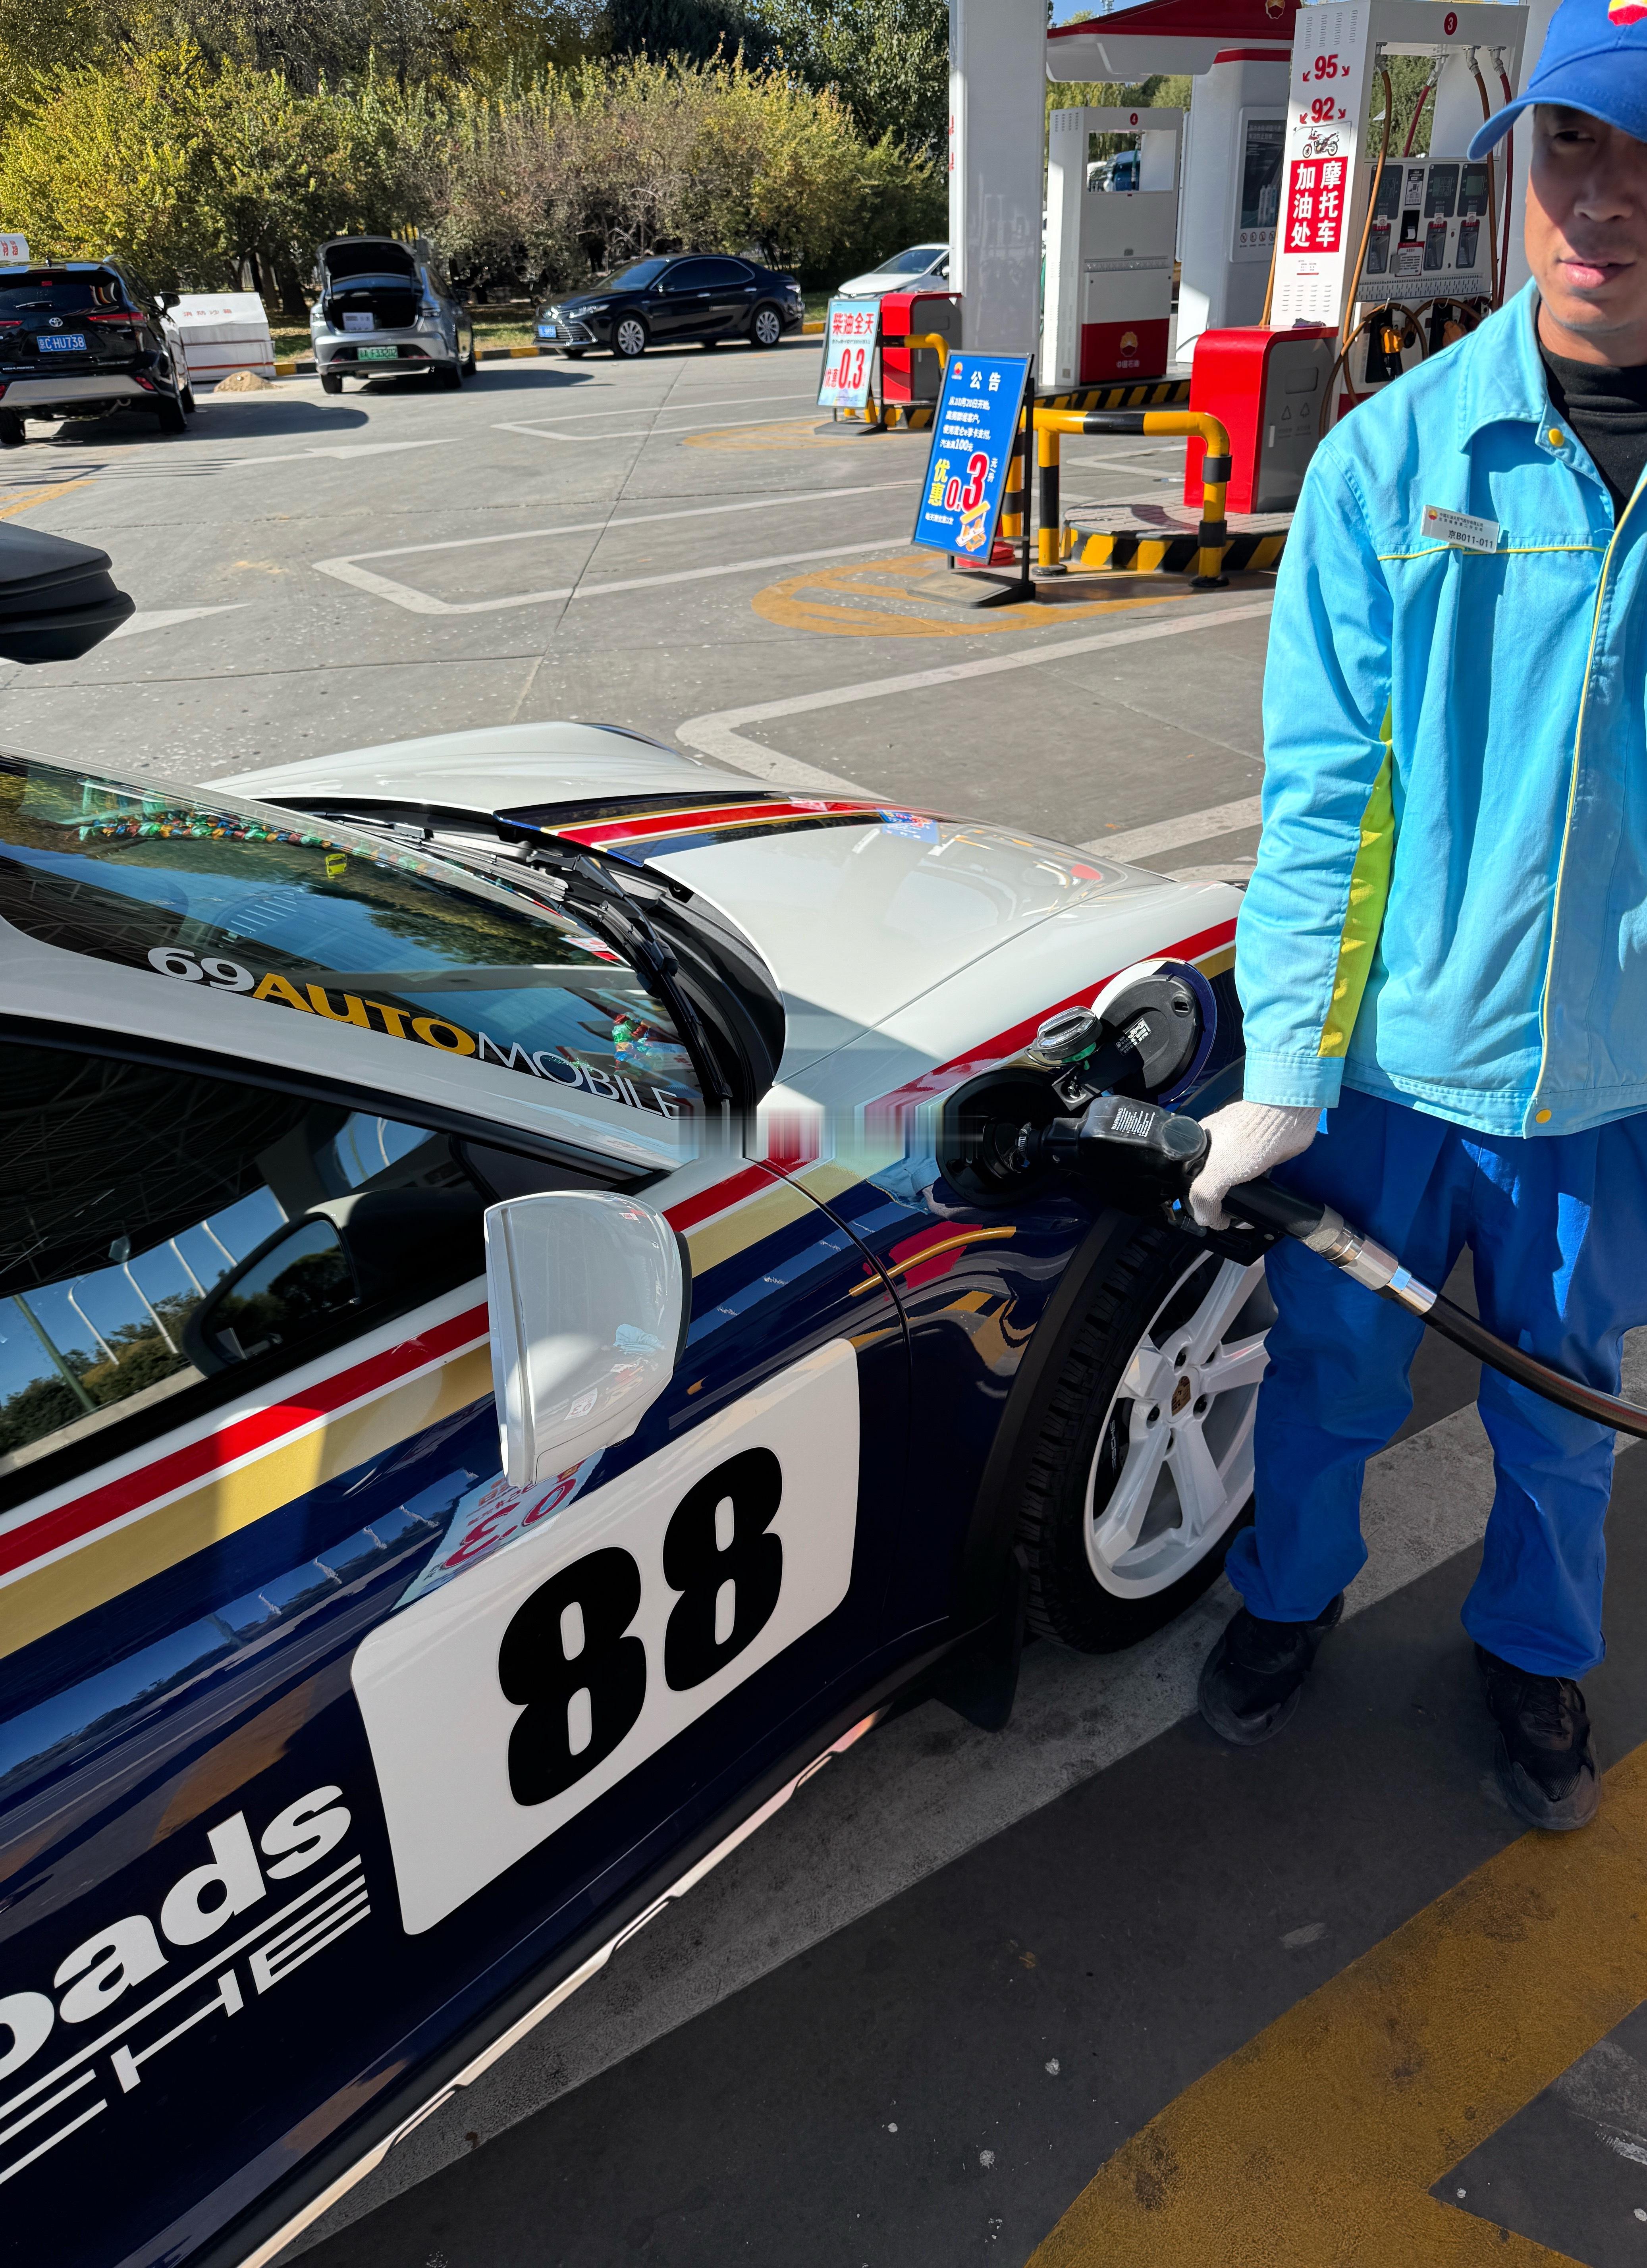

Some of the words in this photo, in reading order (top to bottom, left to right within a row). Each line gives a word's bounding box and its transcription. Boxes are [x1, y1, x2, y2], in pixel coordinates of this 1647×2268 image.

[1448, 17, 1453, 31] 3
[1315, 54, 1338, 80] 95
[1311, 97, 1335, 123] 92
[1290, 163, 1316, 248] 加油处
[1316, 160, 1342, 247] 摩托车
[833, 312, 874, 335] 柴油全天
[838, 349, 865, 390] 0.3
[970, 371, 1001, 392] 公告
[928, 458, 950, 506] 优惠
[944, 451, 990, 514] 0.3
[1448, 530, 1493, 549] 京B011-011
[1111, 1108, 1123, 1130] WARNING
[498, 1446, 783, 1806] 88
